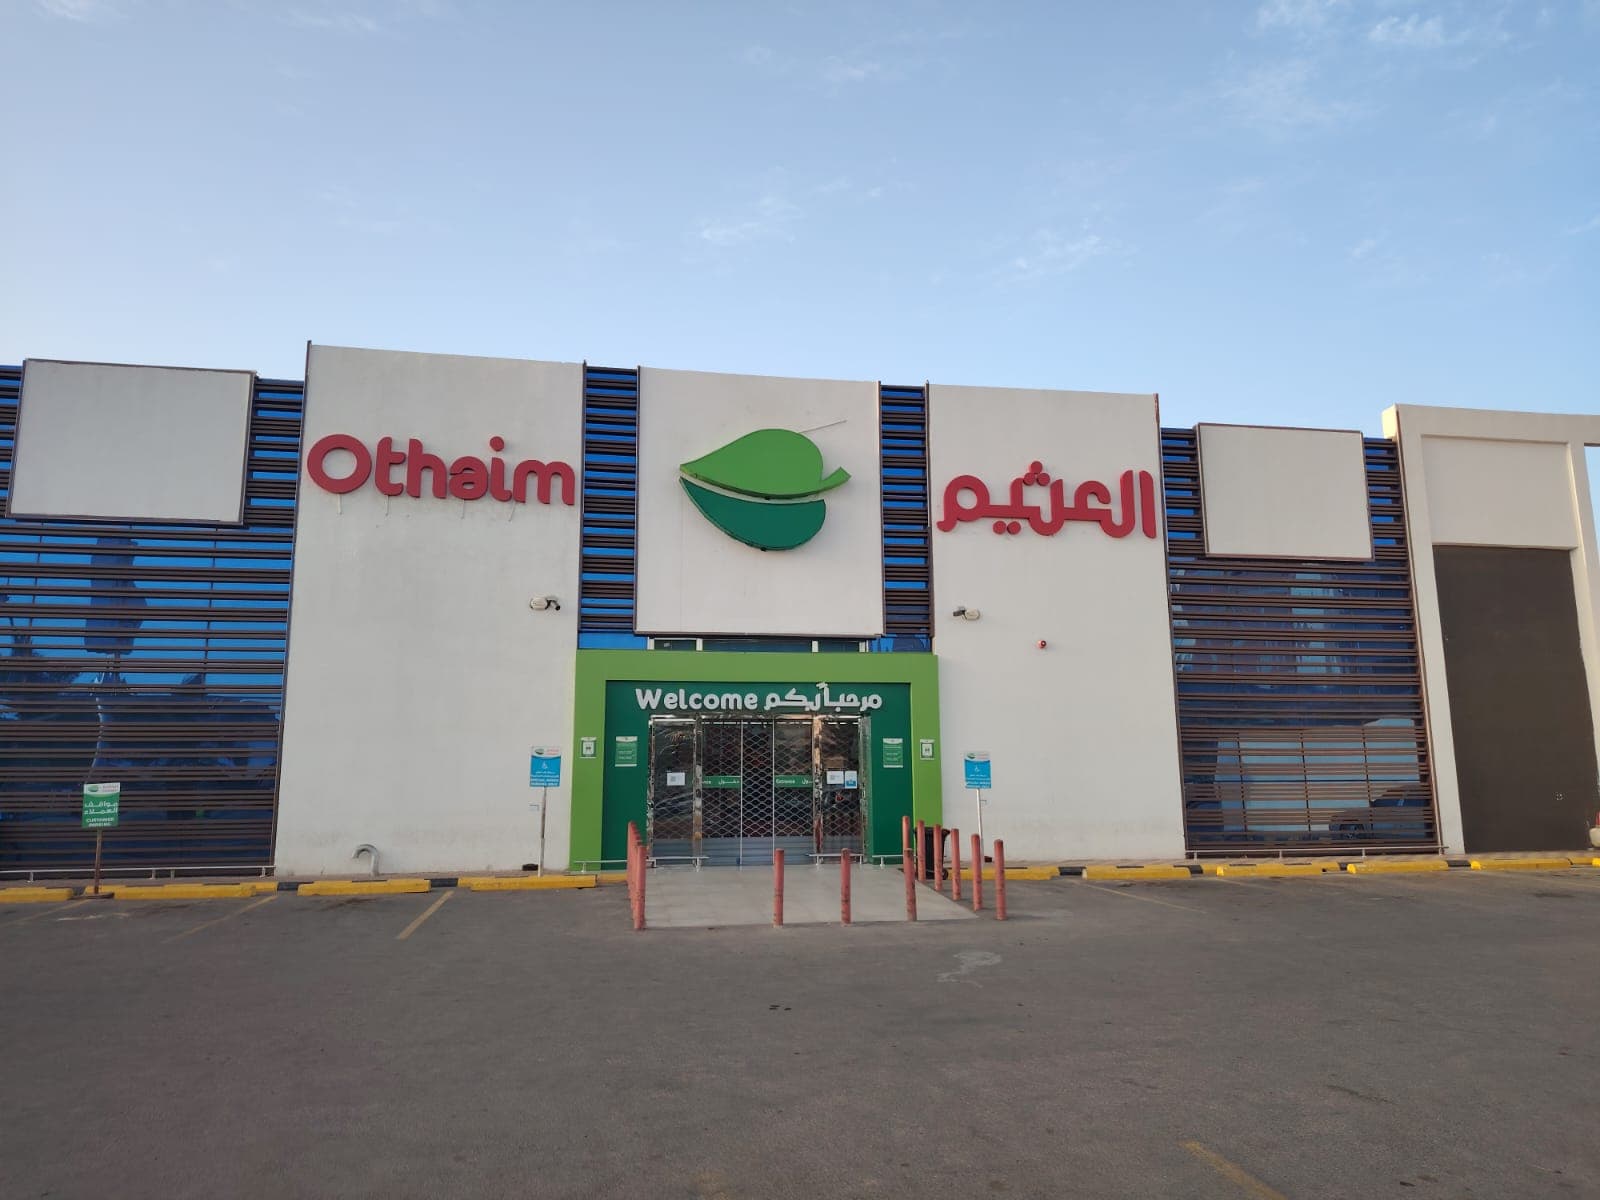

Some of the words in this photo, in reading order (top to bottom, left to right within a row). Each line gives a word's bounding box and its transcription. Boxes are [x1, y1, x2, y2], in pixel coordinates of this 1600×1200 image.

[307, 434, 575, 505] Othaim
[937, 461, 1157, 538] العثيم
[635, 688, 758, 710] Welcome
[763, 687, 821, 711] بكم
